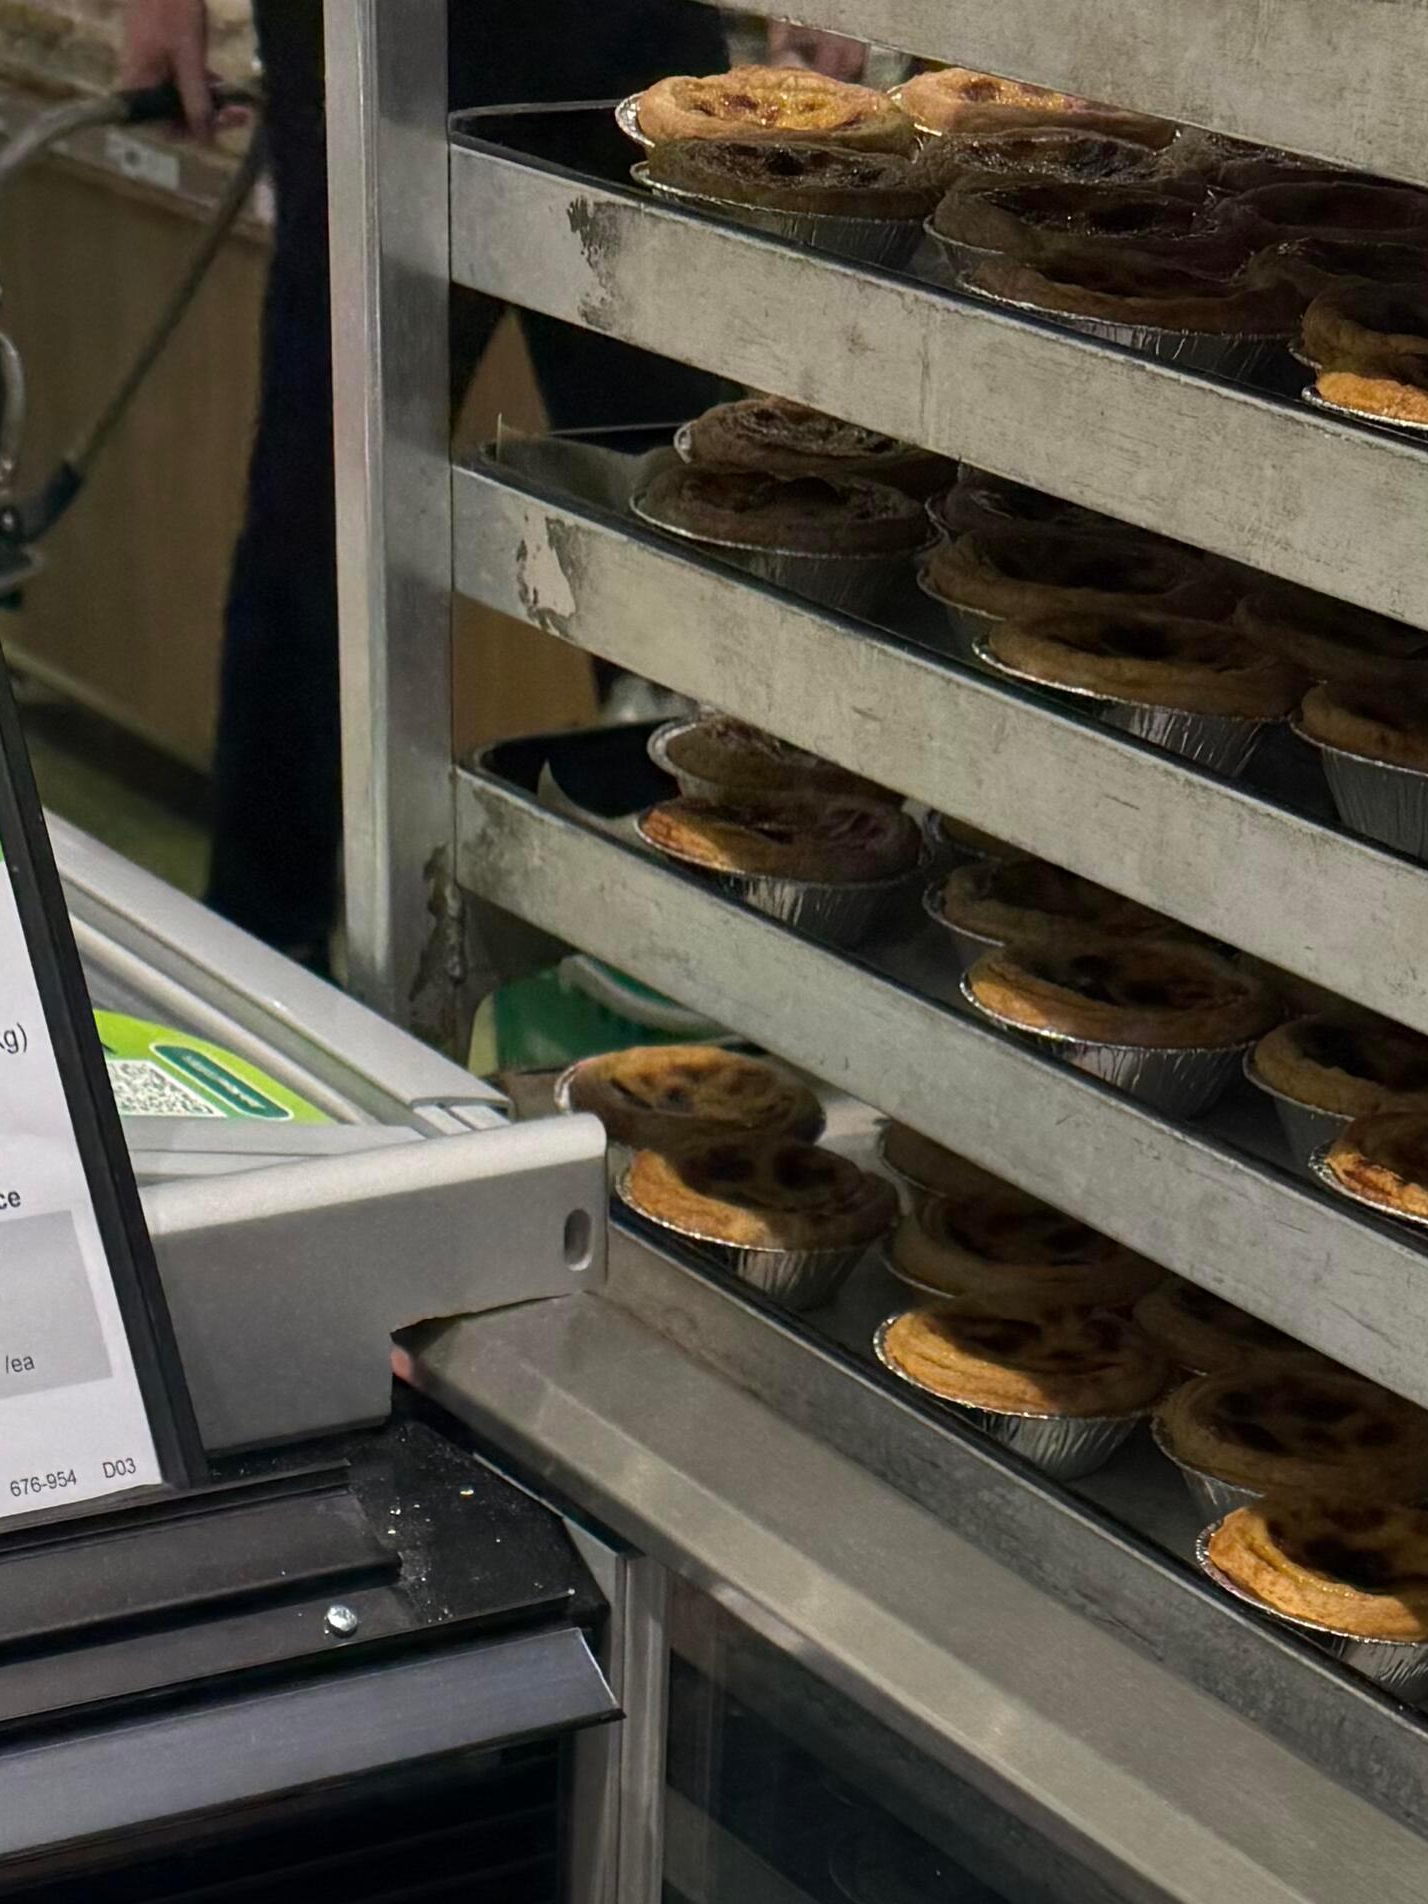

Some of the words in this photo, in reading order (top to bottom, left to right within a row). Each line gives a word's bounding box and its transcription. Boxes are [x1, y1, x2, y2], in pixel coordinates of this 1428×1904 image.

[2, 1350, 36, 1375] /ea
[8, 1468, 78, 1499] 676-954
[102, 1456, 137, 1479] D03
